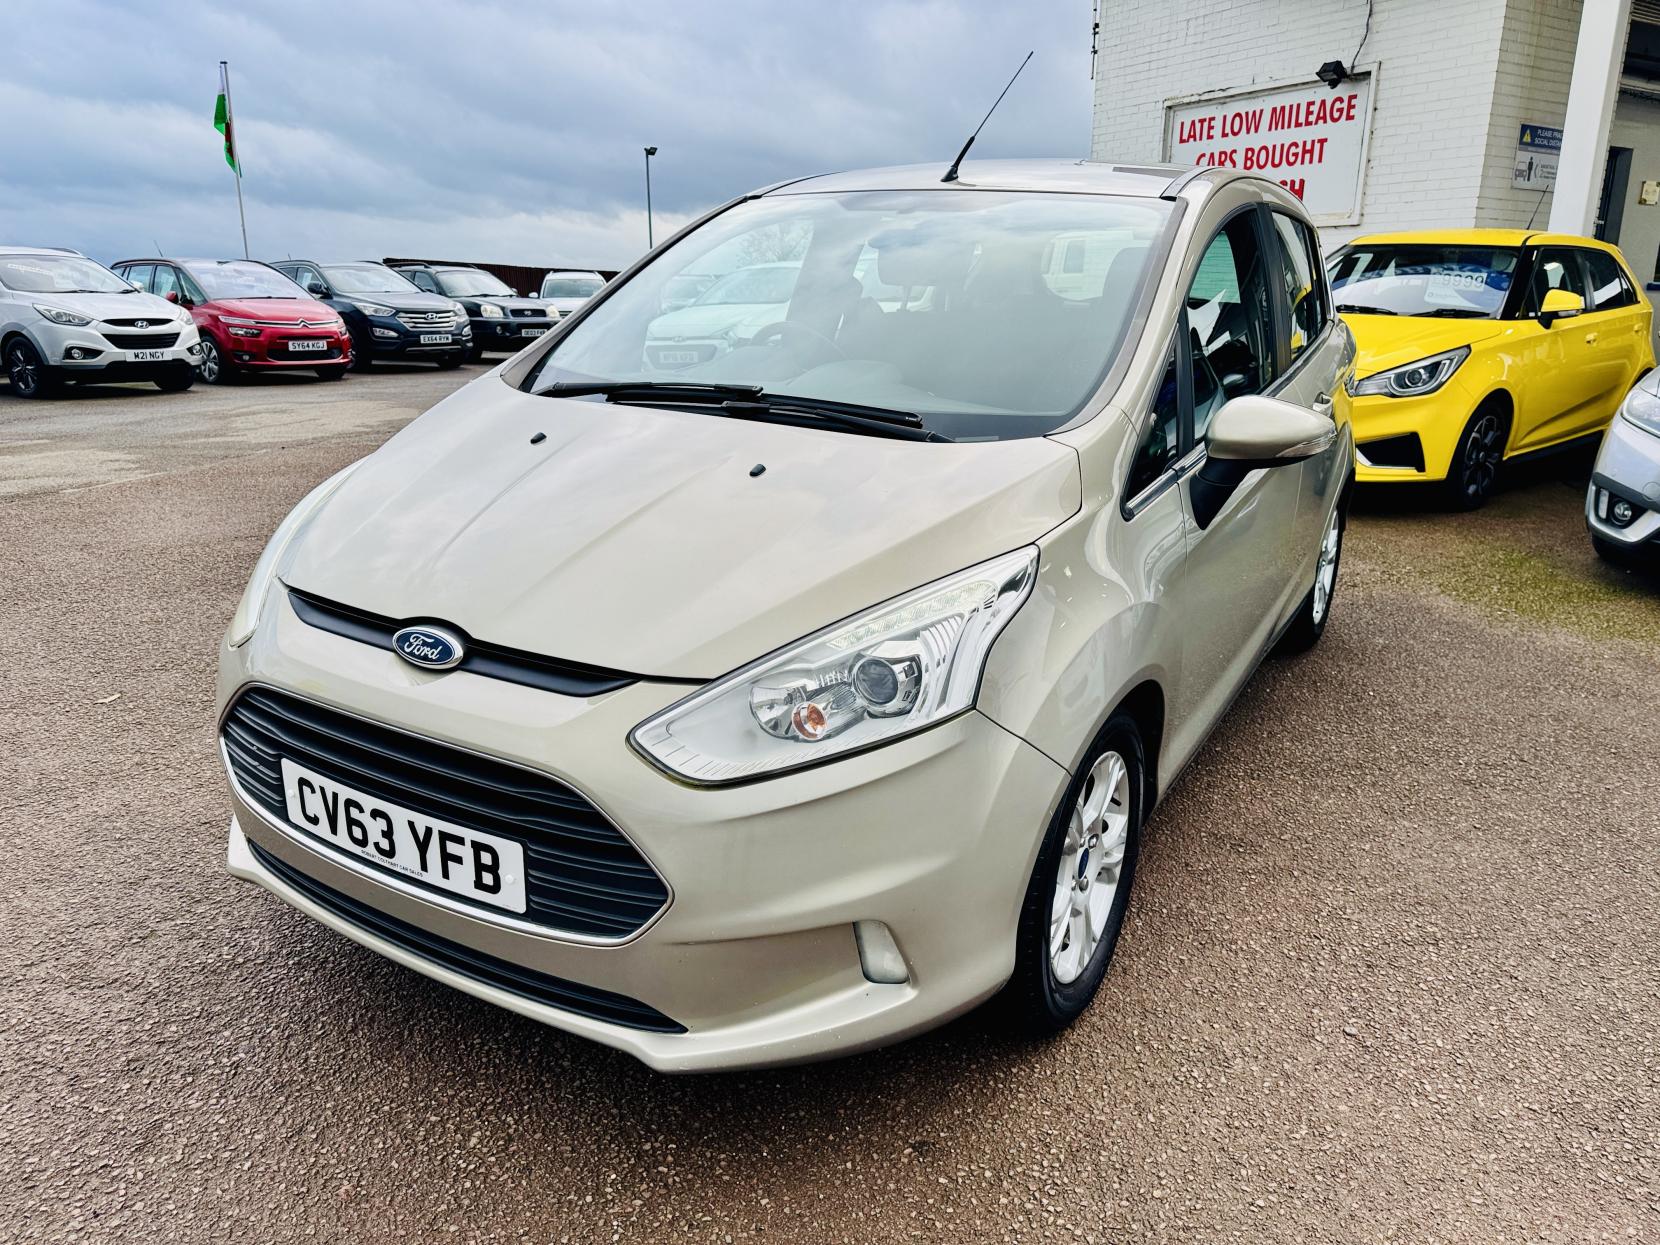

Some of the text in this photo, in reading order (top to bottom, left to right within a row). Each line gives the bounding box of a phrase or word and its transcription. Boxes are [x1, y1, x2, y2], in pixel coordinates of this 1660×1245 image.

[1178, 94, 1358, 144] LATE LOW MILEAGE
[1195, 138, 1328, 171] CARS BOUGHT
[149, 350, 165, 360] NGY
[291, 342, 310, 350] SY64
[403, 633, 441, 660] Ford
[297, 776, 502, 895] CV63 YFB
[399, 864, 408, 872] CAR
[409, 868, 423, 878] SALES
